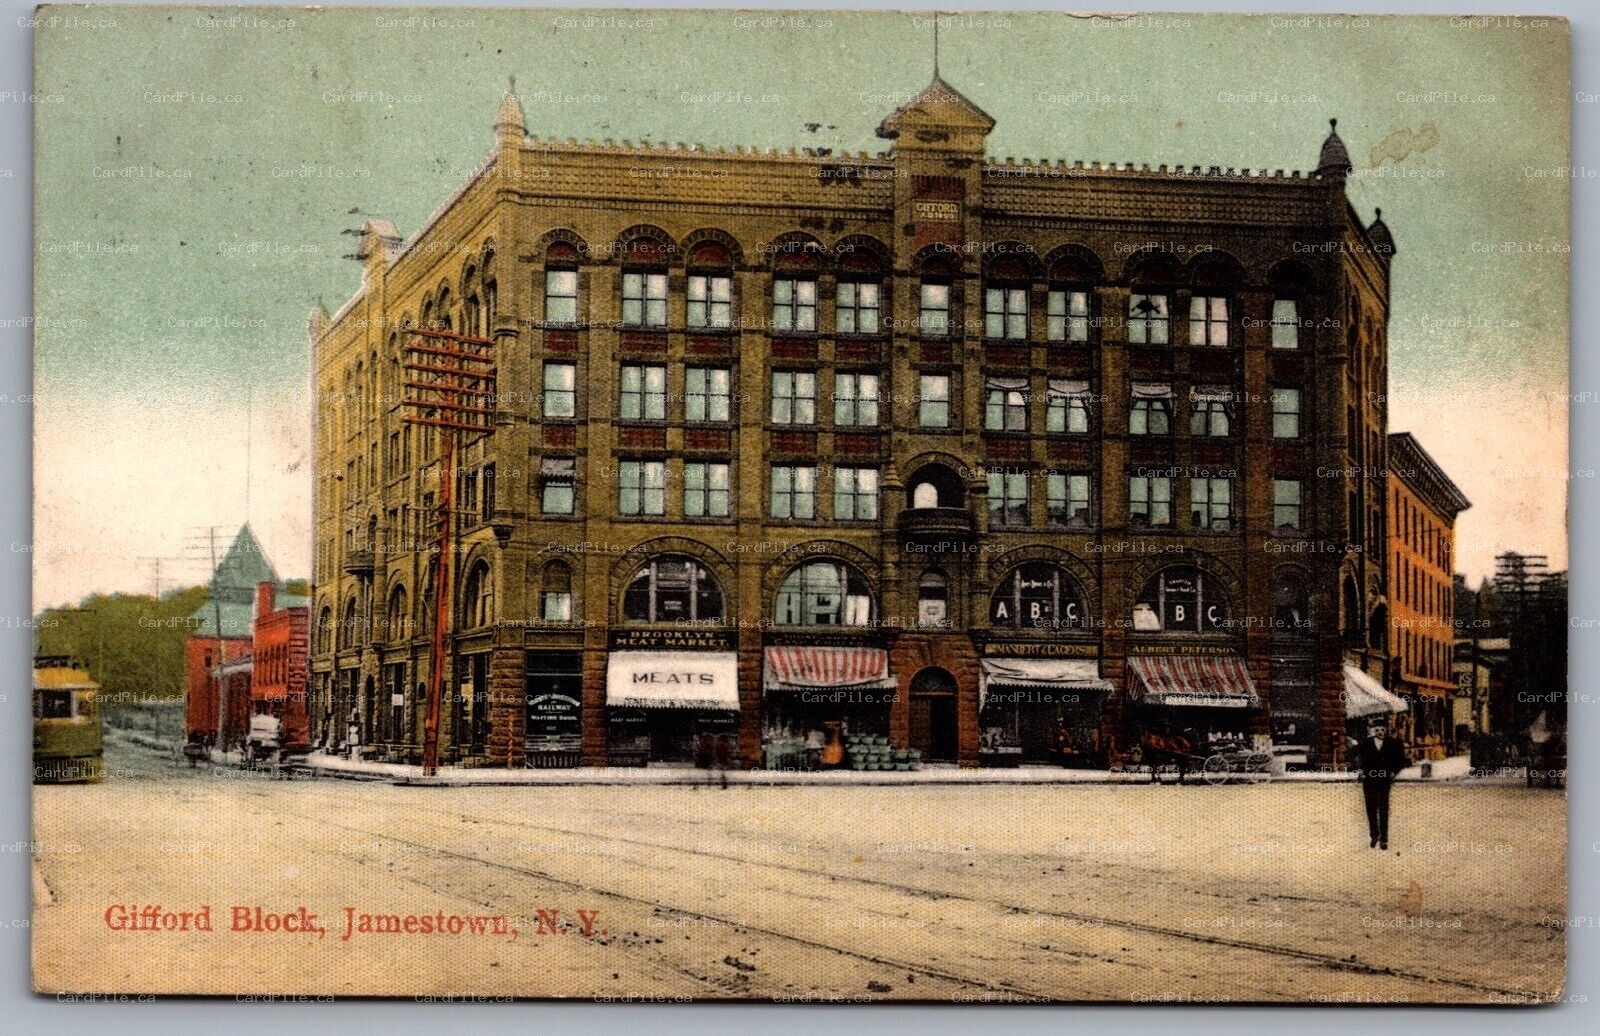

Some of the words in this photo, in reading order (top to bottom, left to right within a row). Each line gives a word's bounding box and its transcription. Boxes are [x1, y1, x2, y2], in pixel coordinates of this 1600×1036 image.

[996, 601, 1009, 618] A
[1030, 602, 1040, 619] B
[1066, 603, 1077, 619] C
[1175, 605, 1185, 622] B
[1207, 605, 1217, 622] C
[616, 638, 658, 646] MEAT
[632, 671, 714, 685] MEATS
